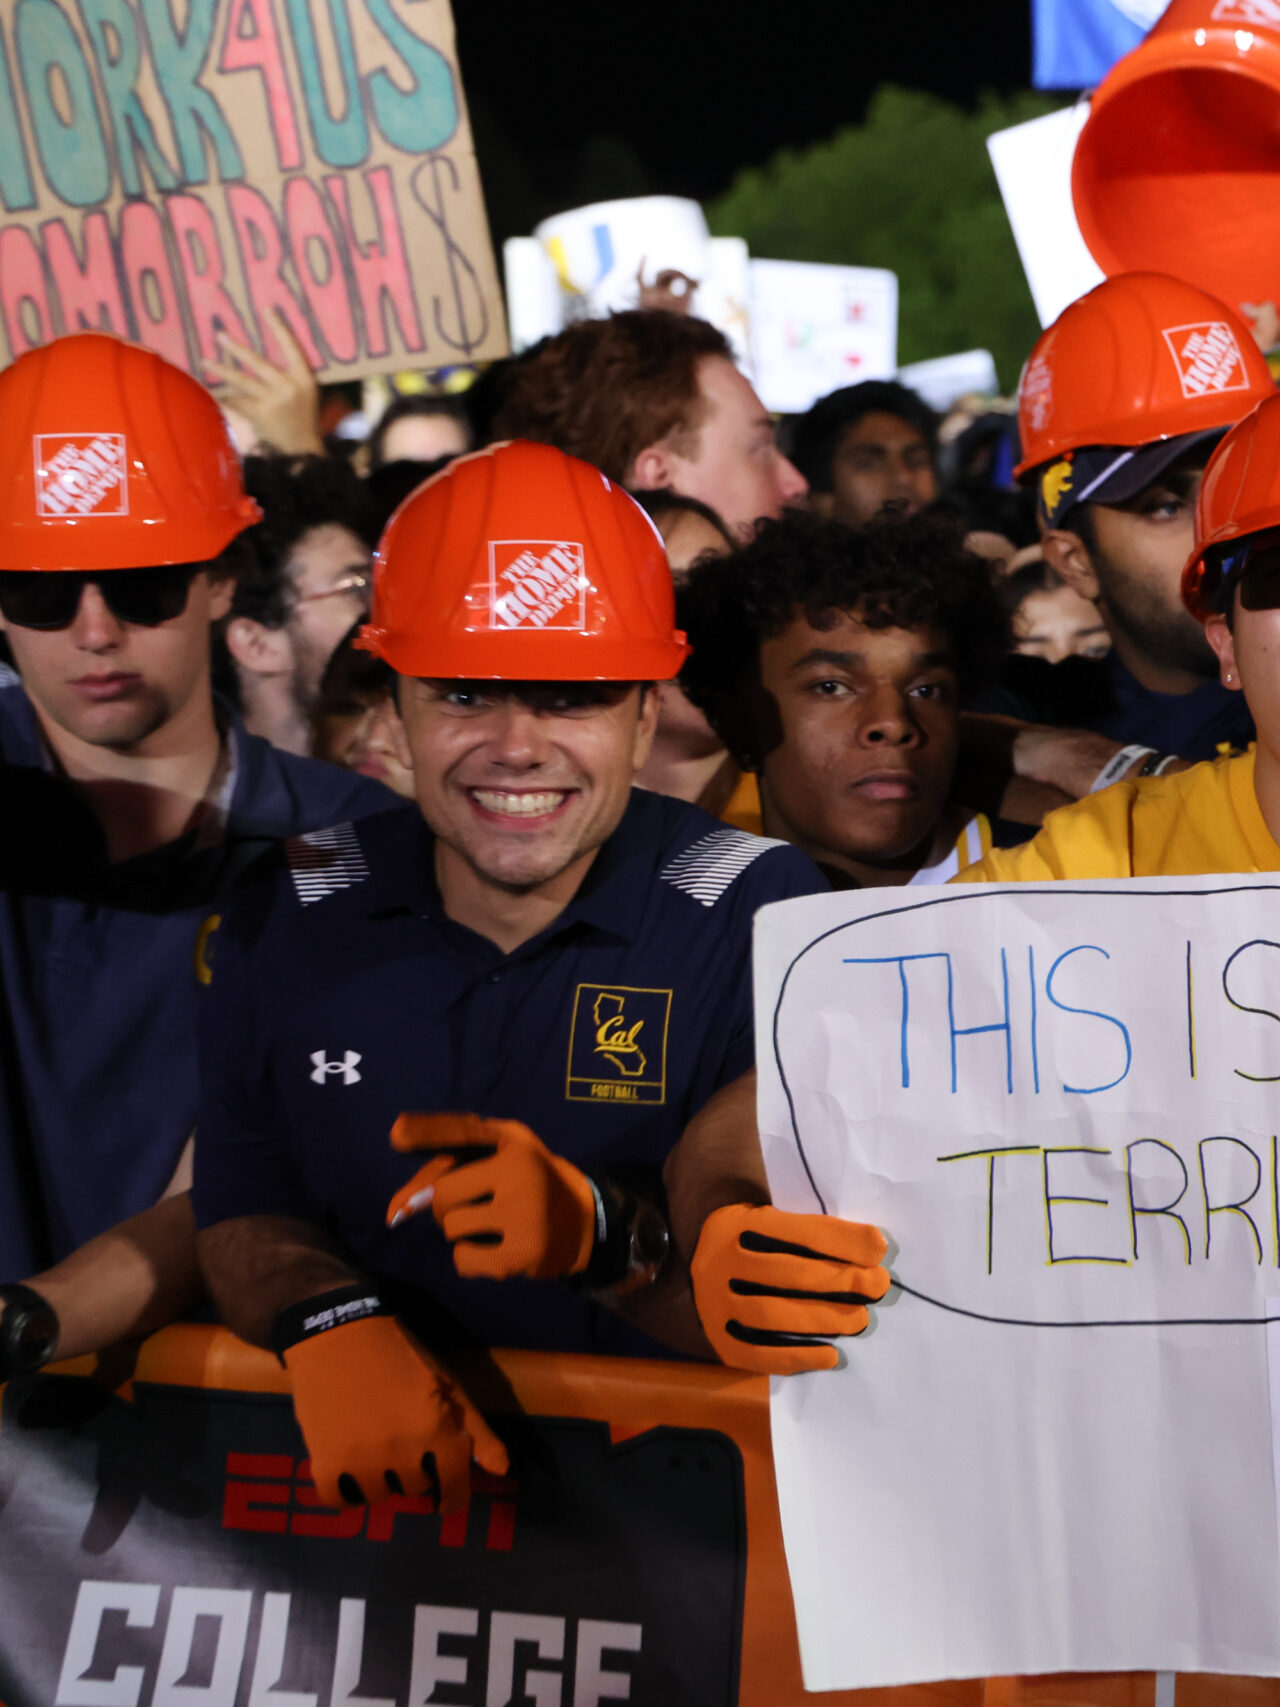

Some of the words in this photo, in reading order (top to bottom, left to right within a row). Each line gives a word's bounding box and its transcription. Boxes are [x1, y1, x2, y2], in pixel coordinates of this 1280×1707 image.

[1183, 323, 1235, 394] HOME
[39, 435, 124, 514] HOME
[73, 466, 124, 514] DEPOT
[494, 543, 583, 627] HOME
[500, 550, 541, 584] THE
[528, 576, 584, 627] DEPOT
[593, 1015, 645, 1053] Cal
[842, 943, 1132, 1095] THIS
[591, 1083, 639, 1100] FOOTBALL
[55, 1579, 643, 1707] COLLEGE
